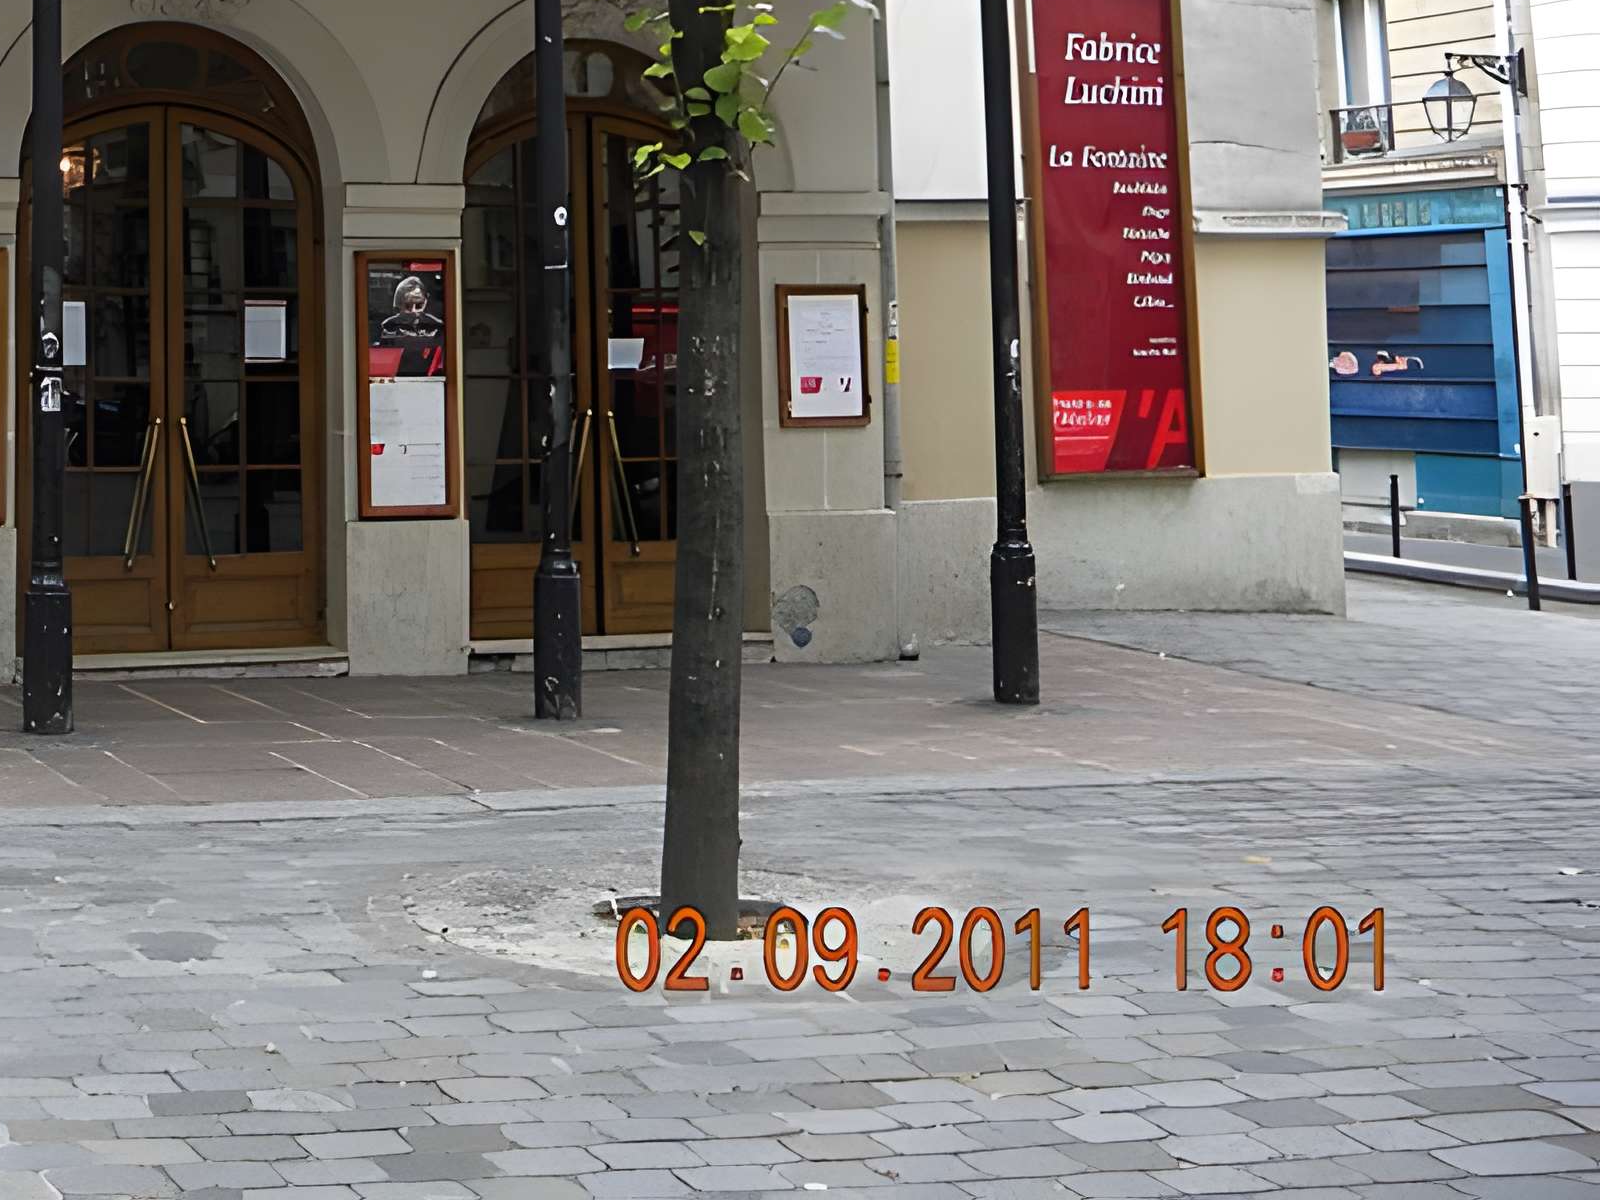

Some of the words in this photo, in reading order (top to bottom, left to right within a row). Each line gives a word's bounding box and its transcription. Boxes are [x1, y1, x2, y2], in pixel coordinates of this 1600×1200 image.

[1064, 31, 1161, 64] Fabrice
[1064, 75, 1164, 106] Luchini
[1049, 144, 1074, 168] La
